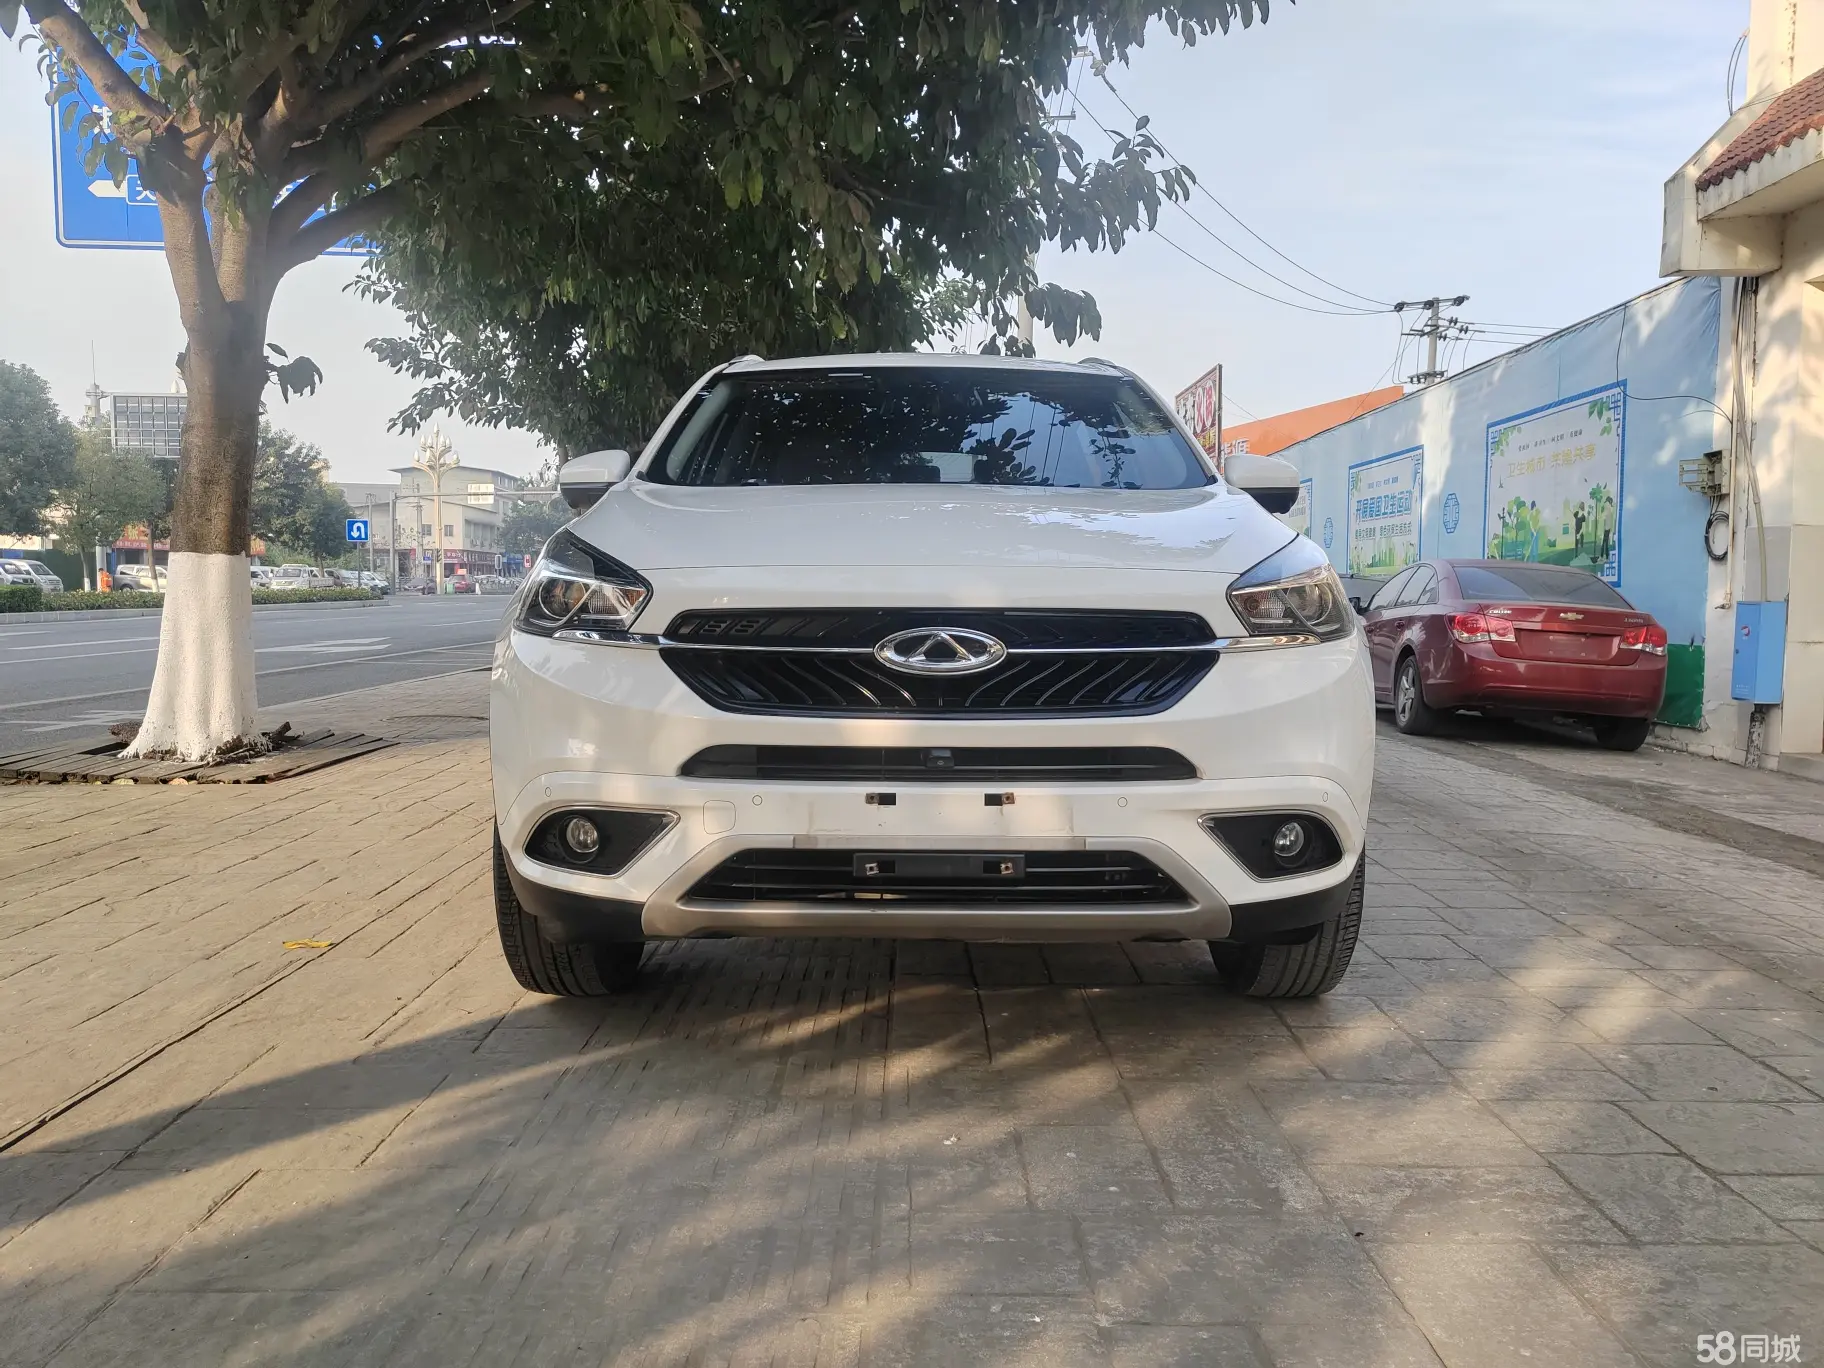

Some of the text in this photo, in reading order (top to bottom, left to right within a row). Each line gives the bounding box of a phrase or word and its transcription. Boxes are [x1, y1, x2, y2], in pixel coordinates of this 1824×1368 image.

[1356, 490, 1412, 522] 开展爱国卫生运动
